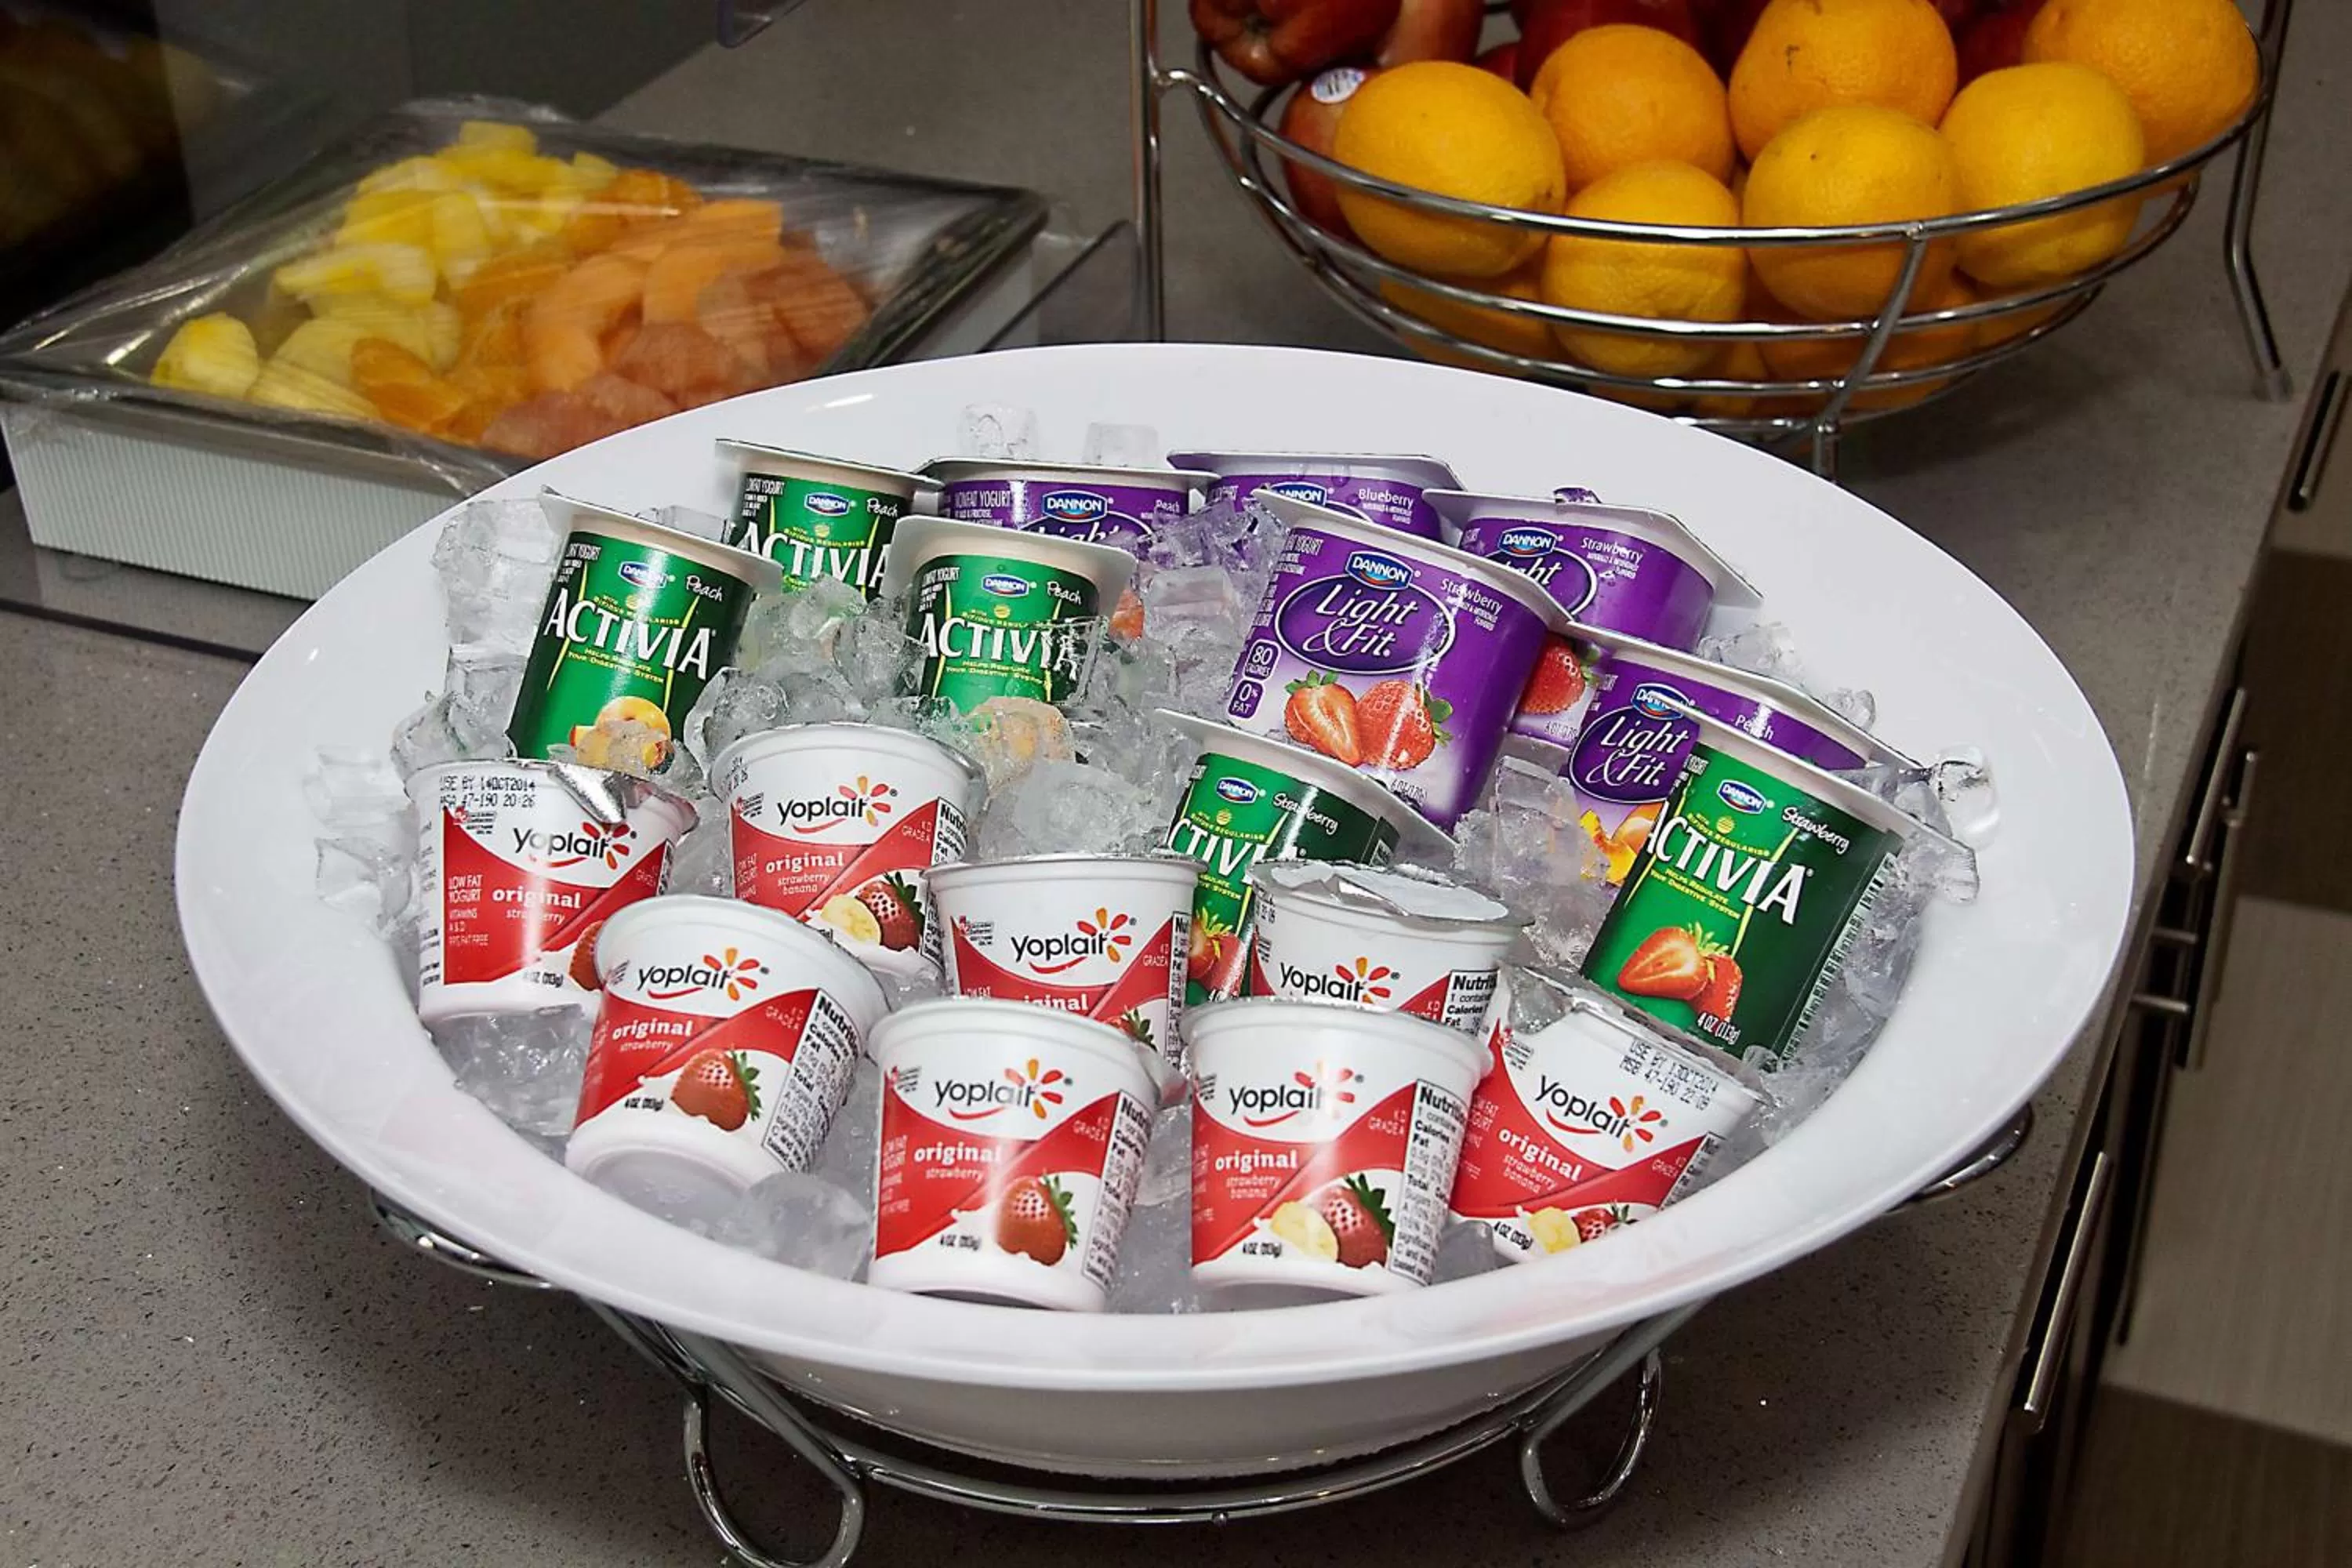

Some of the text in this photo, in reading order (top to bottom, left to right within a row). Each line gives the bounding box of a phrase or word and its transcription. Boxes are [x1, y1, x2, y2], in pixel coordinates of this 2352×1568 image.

[808, 495, 847, 510] DANNON
[866, 497, 898, 518] Peach
[979, 491, 1011, 508] YOGURT
[1046, 496, 1103, 512] DANNON
[1359, 489, 1414, 509] Blueberry
[1502, 533, 1552, 549] DANNON
[1581, 537, 1643, 564] Strawberry
[1352, 557, 1409, 583] DANNON
[685, 575, 723, 602] Peach
[985, 577, 1025, 591] DANNON
[1047, 580, 1083, 605] Peach
[1315, 583, 1418, 627] Light
[543, 588, 711, 681] ACTIVIA
[1341, 622, 1397, 657] Fit
[1253, 644, 1273, 666] 80
[1232, 698, 1252, 713] FAT
[1600, 715, 1690, 757] Light
[1735, 715, 1775, 741] Peh
[1616, 754, 1667, 786] Fit
[1218, 780, 1254, 798] DANNON
[1721, 784, 1764, 810] DANNON
[1781, 807, 1850, 855] Strawberry
[1167, 818, 1298, 885] CTIVI
[765, 851, 844, 874] original
[1647, 800, 1806, 925] ACTIVIA
[466, 874, 483, 887] FAT
[778, 873, 830, 887] strawberry
[782, 884, 818, 895] banana
[448, 888, 482, 903] YOGURT
[506, 907, 565, 926] straerry
[1453, 975, 1497, 990] Nutri
[1024, 993, 1088, 1011] inal
[612, 1018, 693, 1040] original
[1445, 1017, 1461, 1026] Fat
[619, 1038, 673, 1052] strawberry
[1368, 1117, 1397, 1134] GRADE
[1413, 1133, 1429, 1148] Fat
[913, 1141, 1000, 1164] original
[1215, 1149, 1298, 1172] original
[1498, 1127, 1584, 1183] original
[925, 1167, 984, 1182] strawberry
[1225, 1174, 1281, 1189] strawberry
[1502, 1154, 1558, 1191] strawberry
[1503, 1167, 1541, 1194] banana
[1229, 1186, 1269, 1200] banana
[1407, 1174, 1428, 1192] Total
